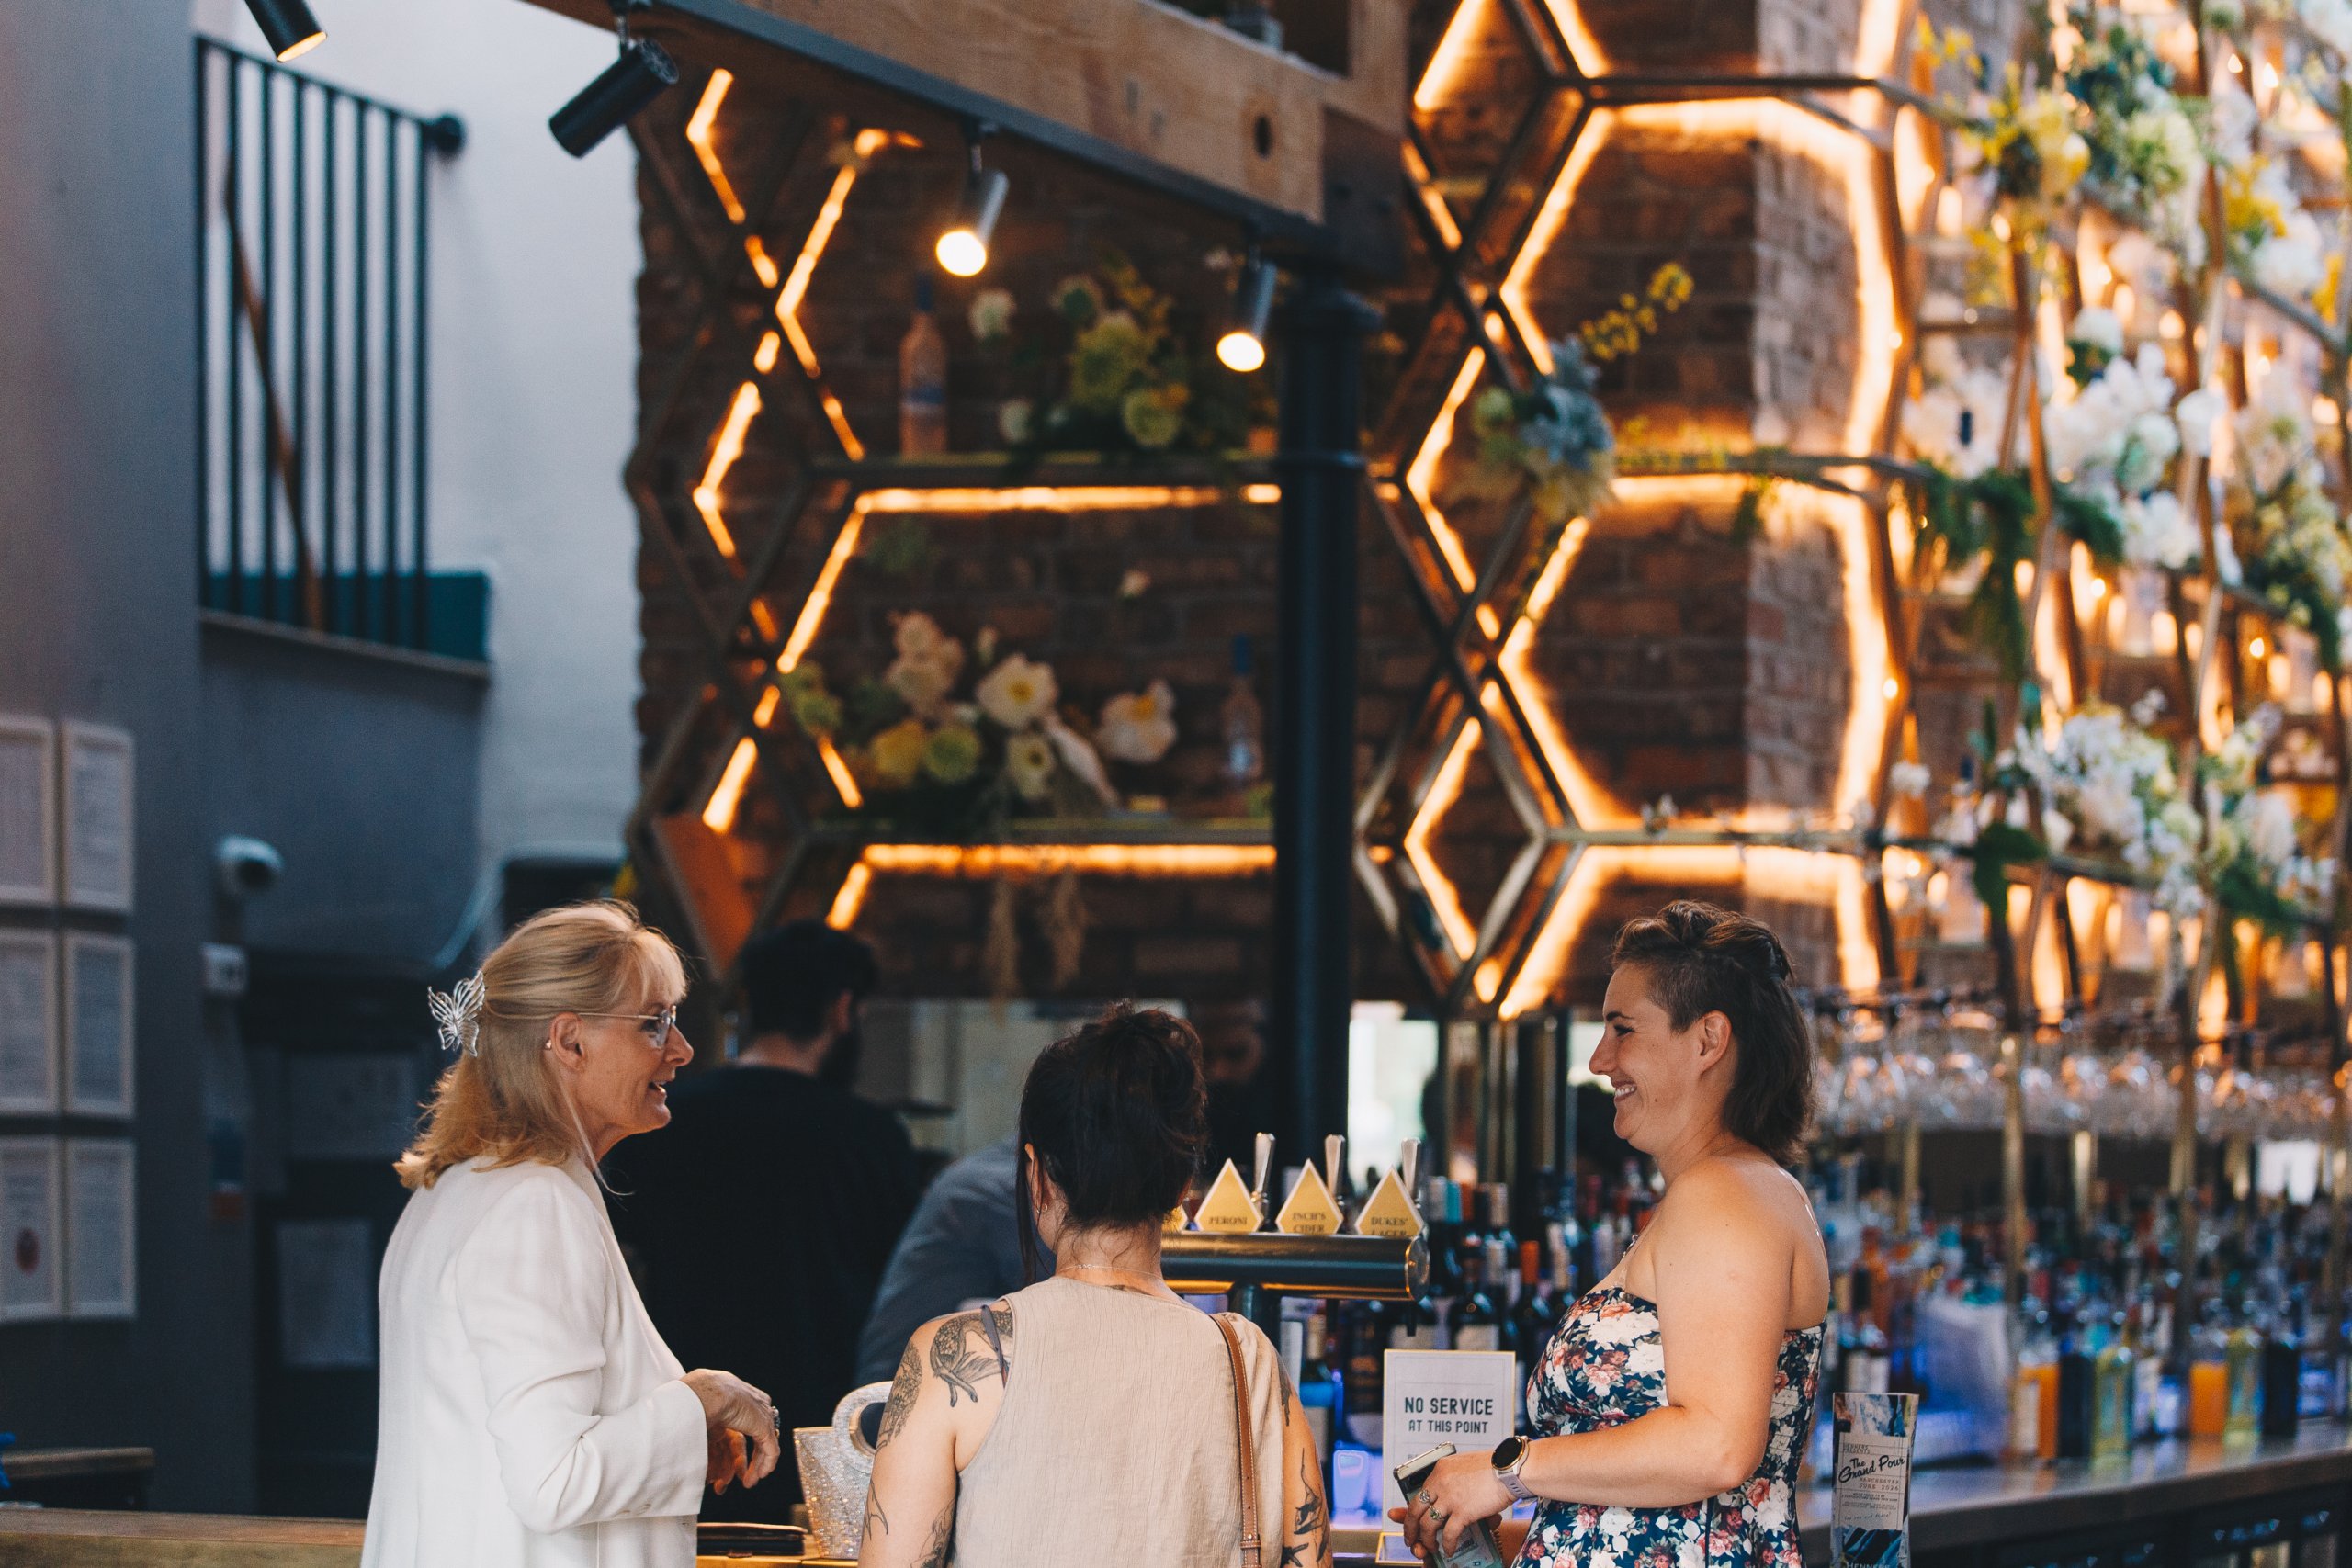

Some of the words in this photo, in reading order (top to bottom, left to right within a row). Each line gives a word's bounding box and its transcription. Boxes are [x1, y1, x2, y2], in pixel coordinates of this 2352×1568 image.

[1208, 1216, 1248, 1225] PERONI
[1293, 1224, 1325, 1234] CIDER
[1405, 1396, 1423, 1414] NO
[1430, 1397, 1493, 1416] SERVICE
[1408, 1419, 1422, 1432] AT
[1428, 1420, 1452, 1433] THIS
[1455, 1421, 1488, 1434] POINT
[1838, 1460, 1876, 1483] Grand
[1879, 1454, 1905, 1472] Pour
[1849, 1457, 1866, 1468] The
